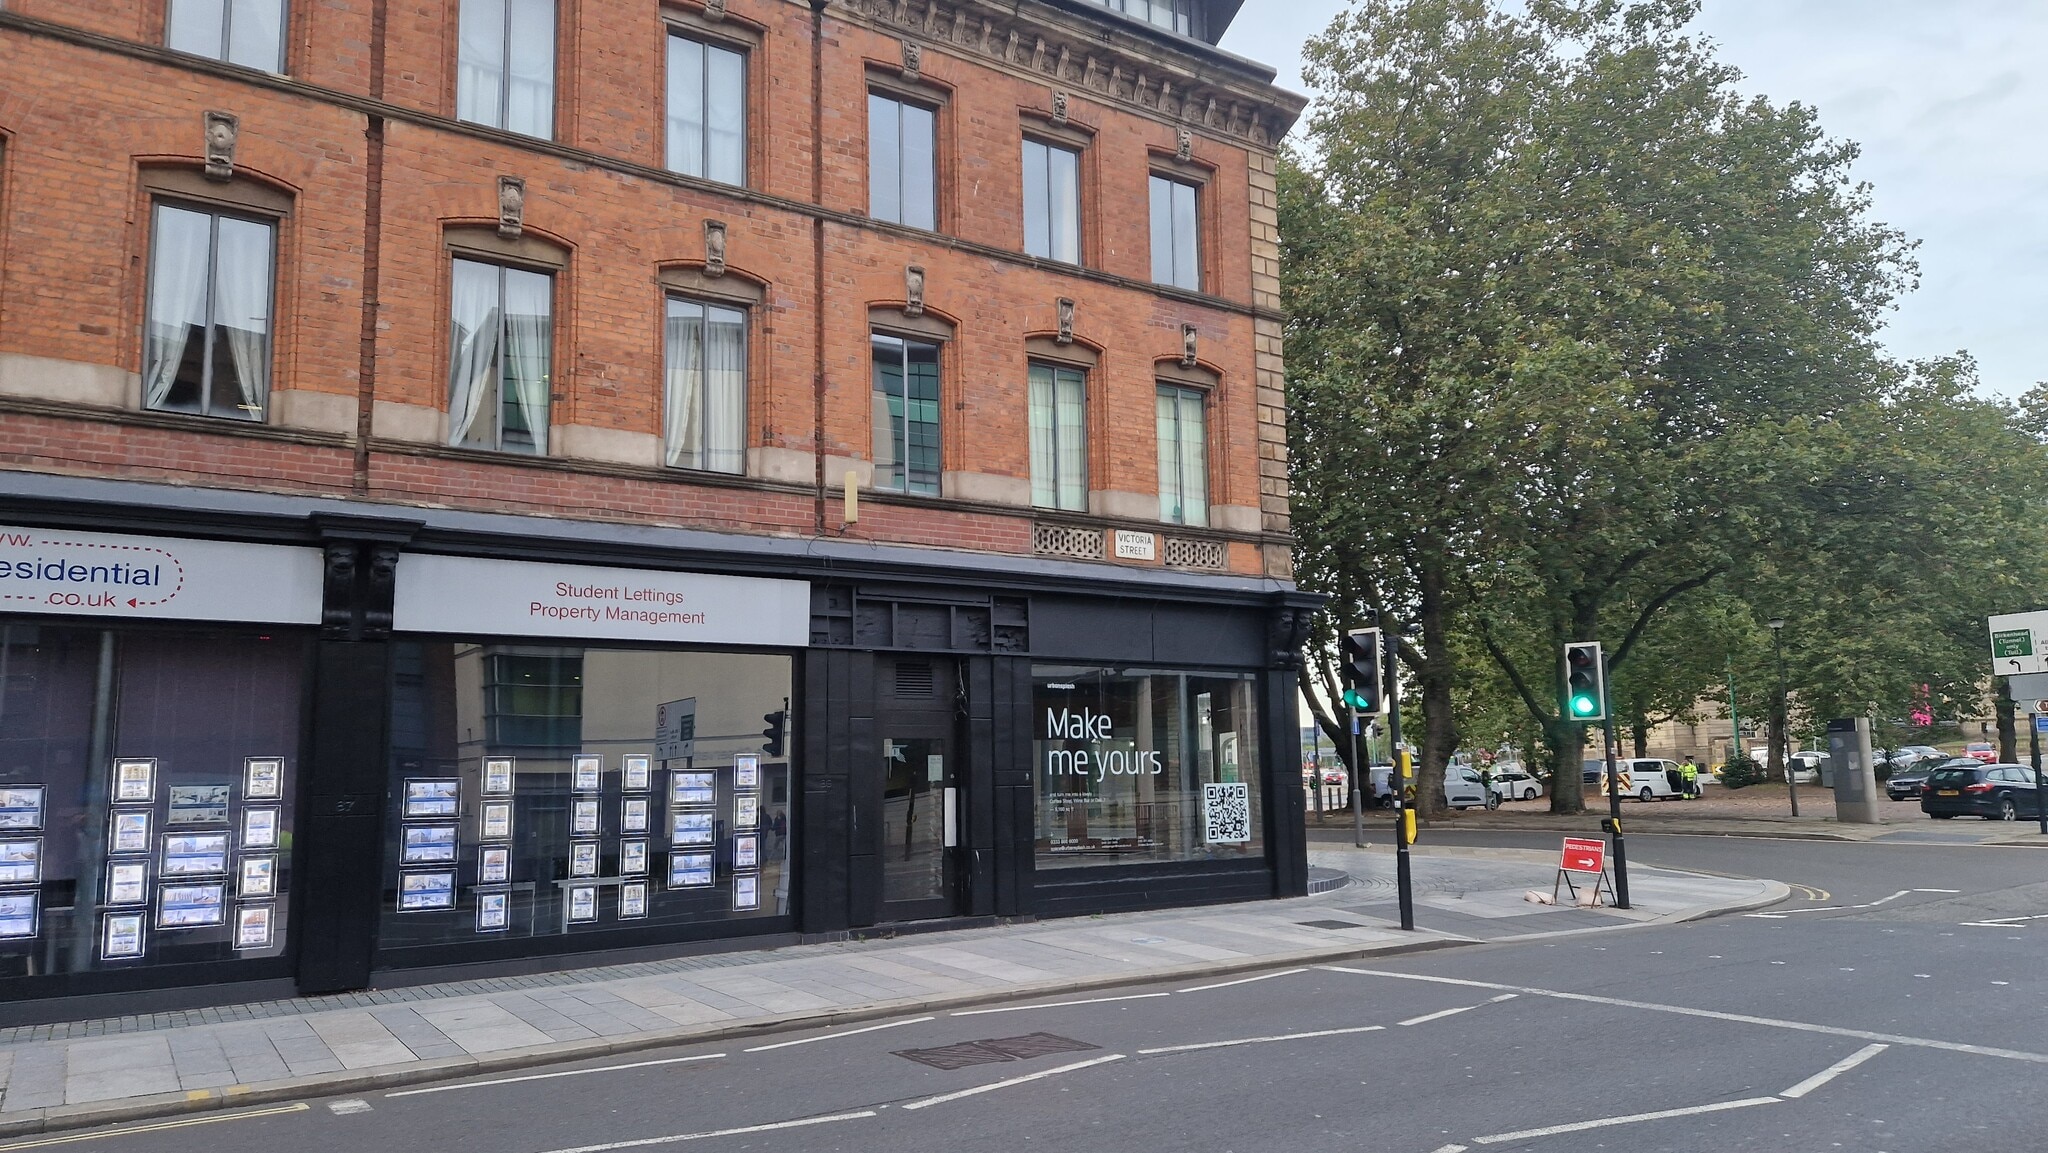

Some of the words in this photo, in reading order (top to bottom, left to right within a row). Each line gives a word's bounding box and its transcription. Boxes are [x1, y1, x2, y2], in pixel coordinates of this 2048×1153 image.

[1118, 533, 1152, 545] VICTORIA
[1119, 545, 1146, 555] STREET
[44, 591, 116, 607] .co.uk
[556, 582, 619, 600] Student
[624, 586, 684, 605] Lettings
[530, 602, 601, 622] Property
[605, 606, 705, 625] Management
[1994, 630, 2029, 639] Birkenhead
[1047, 706, 1112, 739] Make
[1048, 750, 1089, 775] me
[1094, 750, 1162, 783] yours
[1565, 844, 1602, 853] PEDESTRIANS
